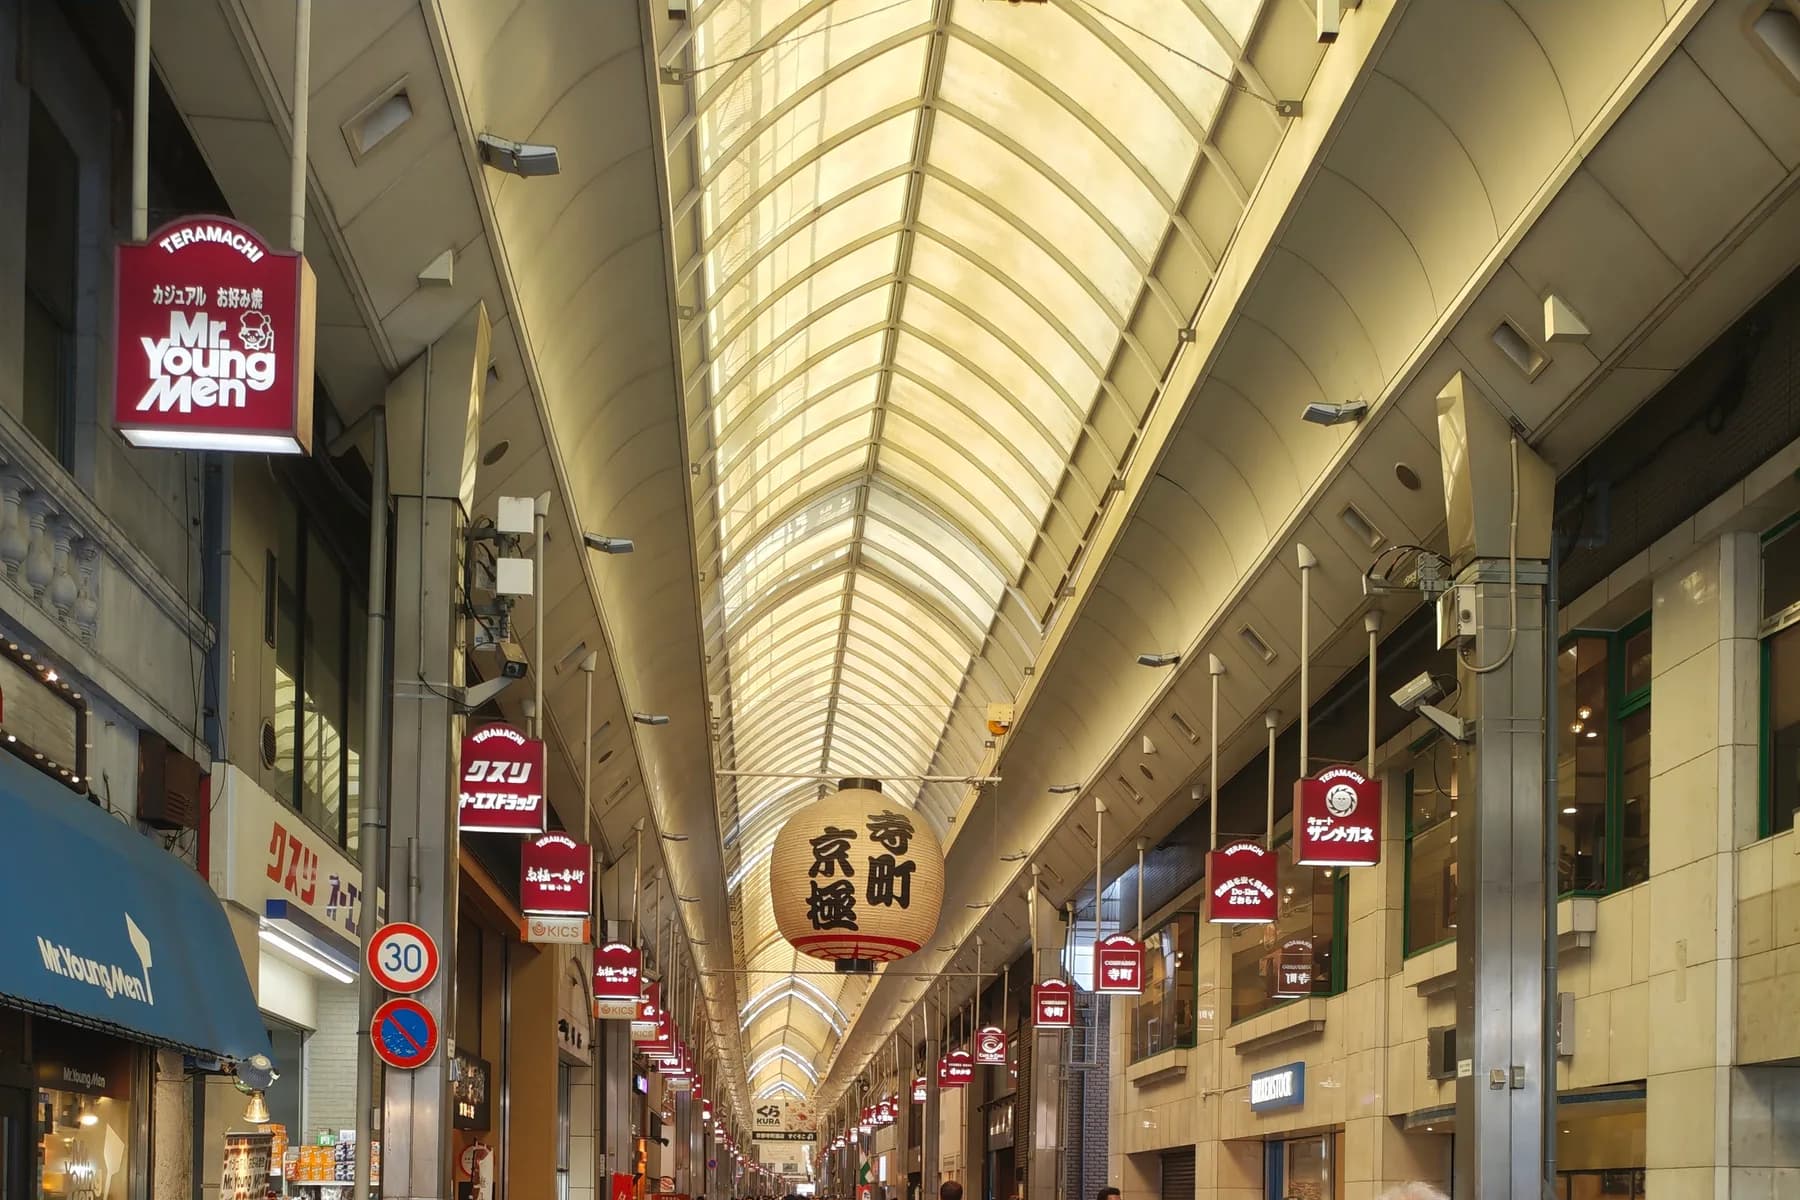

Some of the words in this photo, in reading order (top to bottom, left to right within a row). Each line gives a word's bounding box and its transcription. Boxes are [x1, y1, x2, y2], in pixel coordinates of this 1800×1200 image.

[159, 226, 264, 263] TERAMACHI
[153, 284, 207, 306] カジュアル
[217, 287, 264, 309] お好み焼
[170, 310, 230, 349] Mr.
[140, 337, 276, 391] Young
[136, 375, 246, 413] Men
[472, 728, 526, 746] TERAMACHI
[464, 760, 533, 784] クスリ
[1318, 769, 1365, 785] TERAMACHI
[459, 792, 542, 811] オーエスドラッグ
[535, 835, 577, 850] TERAMACHI
[1307, 826, 1374, 843] サンメガネ
[865, 809, 917, 910] 寺町
[1225, 844, 1265, 857] TERAMACHI
[266, 821, 318, 906] クスリ
[805, 826, 859, 931] 京極
[326, 874, 361, 938] オーエ
[547, 926, 580, 938] KICS
[384, 942, 422, 973] 30
[611, 1006, 635, 1016] KICS
[756, 1105, 780, 1118] くら
